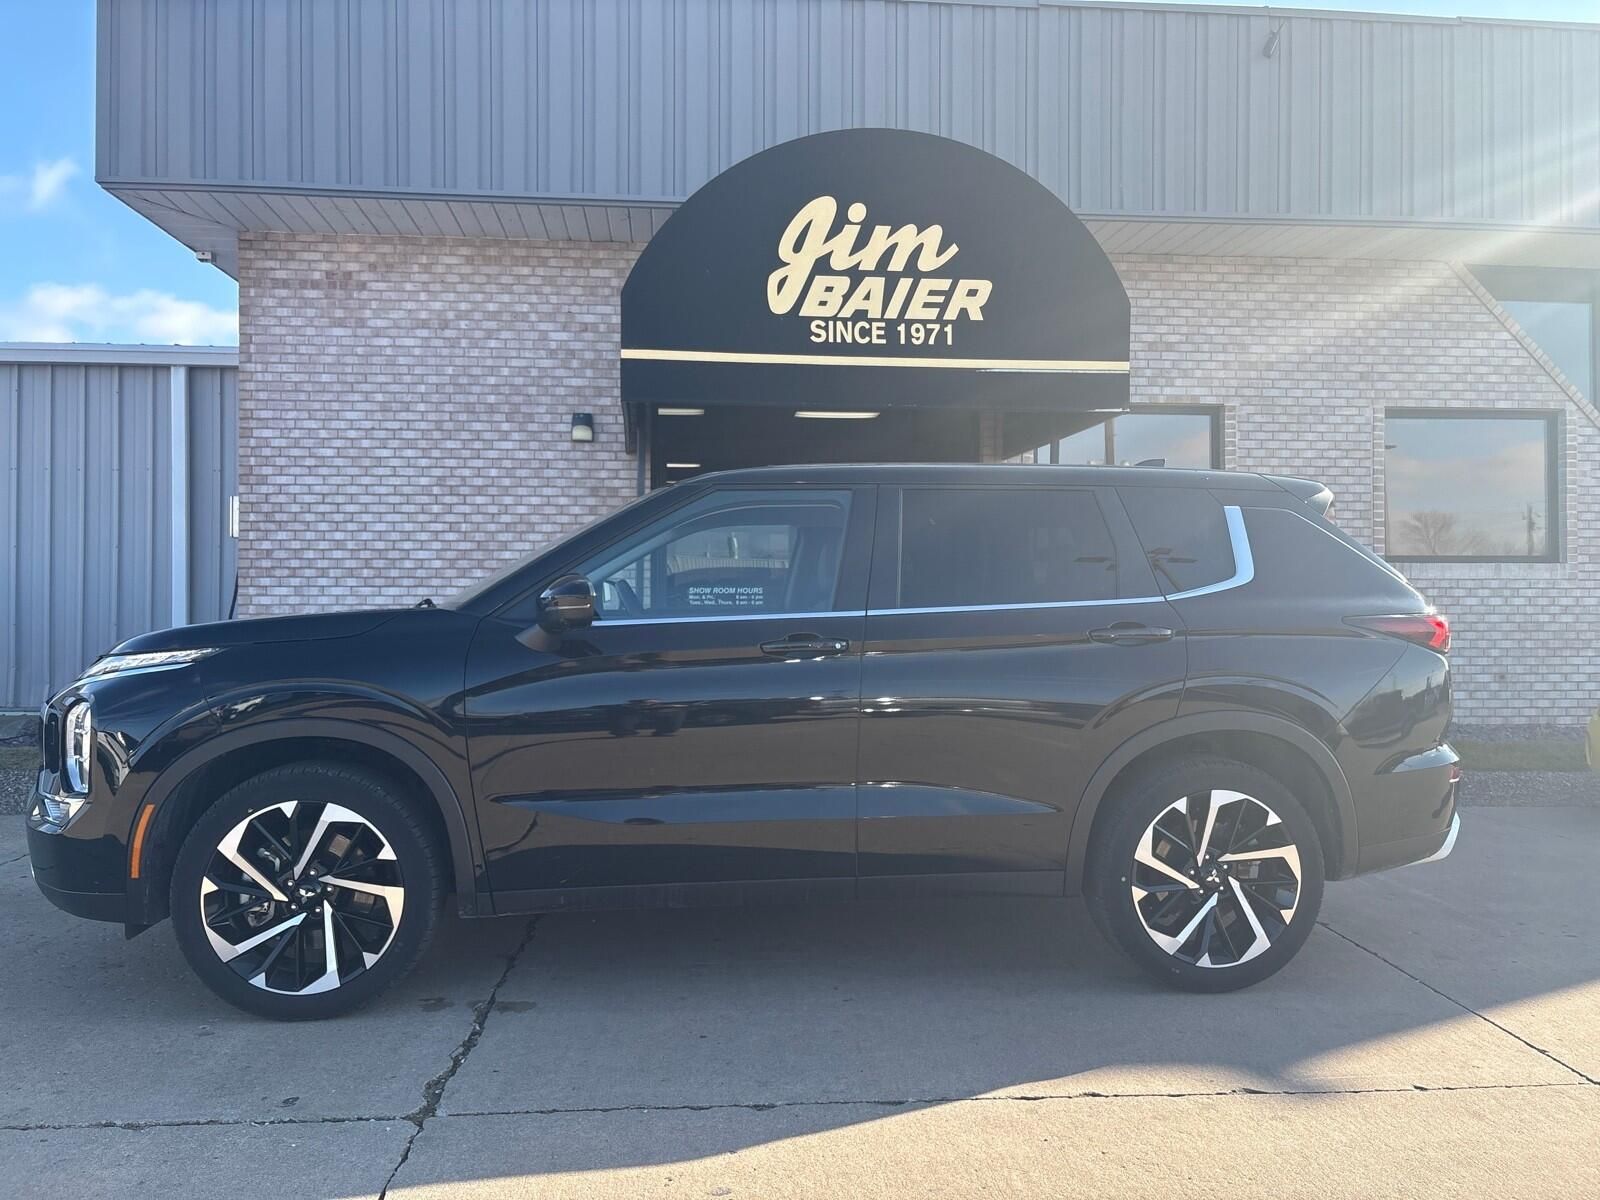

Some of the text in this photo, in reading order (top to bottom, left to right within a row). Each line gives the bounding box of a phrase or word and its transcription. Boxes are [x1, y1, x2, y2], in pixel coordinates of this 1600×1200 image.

[767, 195, 959, 315] Jim
[798, 275, 993, 321] BAIER
[810, 320, 953, 345] SINCE 1971
